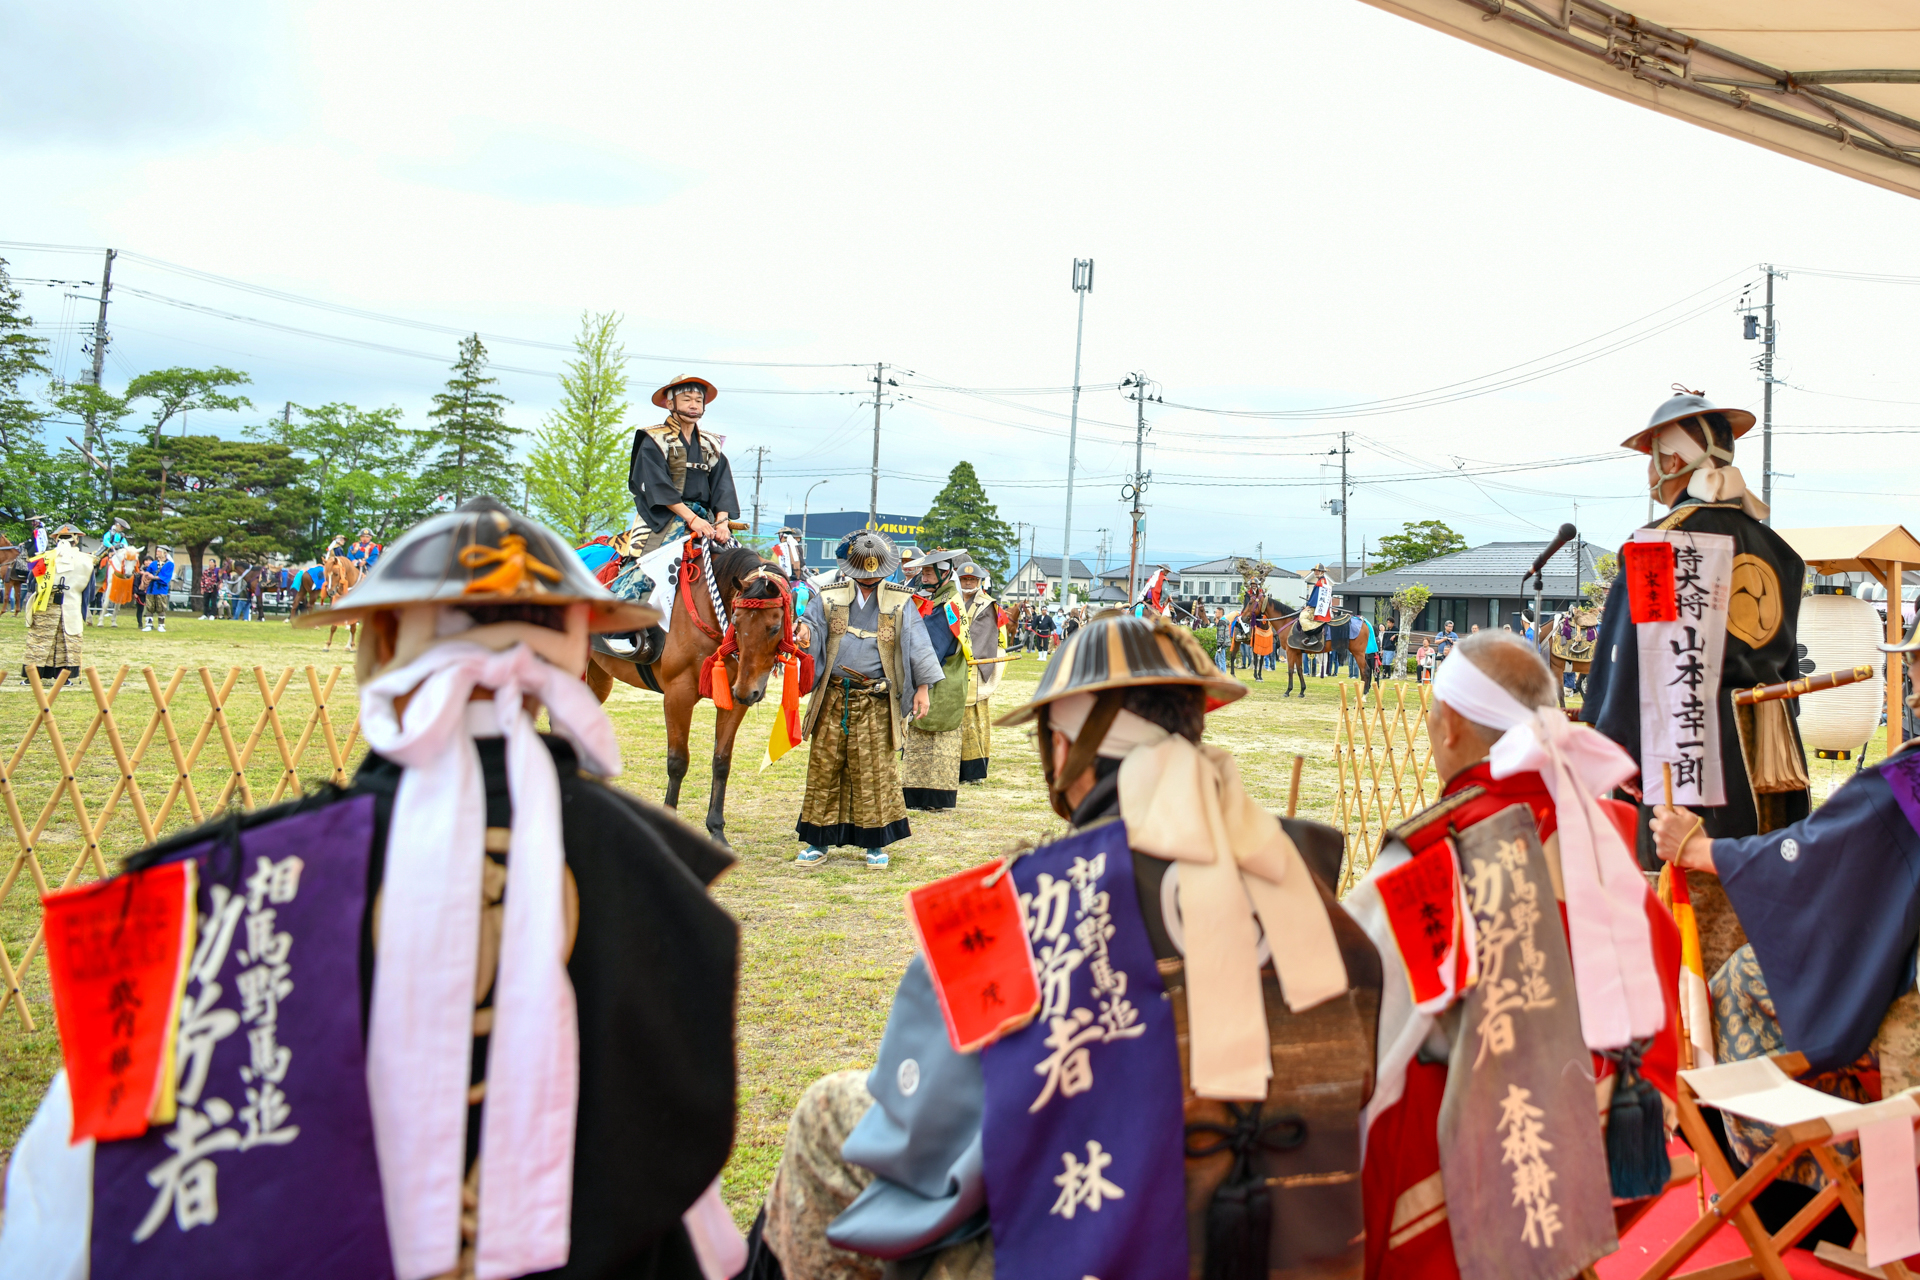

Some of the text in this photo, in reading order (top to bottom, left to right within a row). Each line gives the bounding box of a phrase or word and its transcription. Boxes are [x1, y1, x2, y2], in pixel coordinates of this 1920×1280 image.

[1667, 545, 1710, 797] 侍大将 山本幸一郎
[235, 855, 305, 1152] 相馬野馬追
[1067, 852, 1147, 1044] 相馬野馬追
[1465, 857, 1525, 1072] 功労者
[1495, 838, 1556, 1012] 相馬野馬追
[1050, 1139, 1125, 1219] 林
